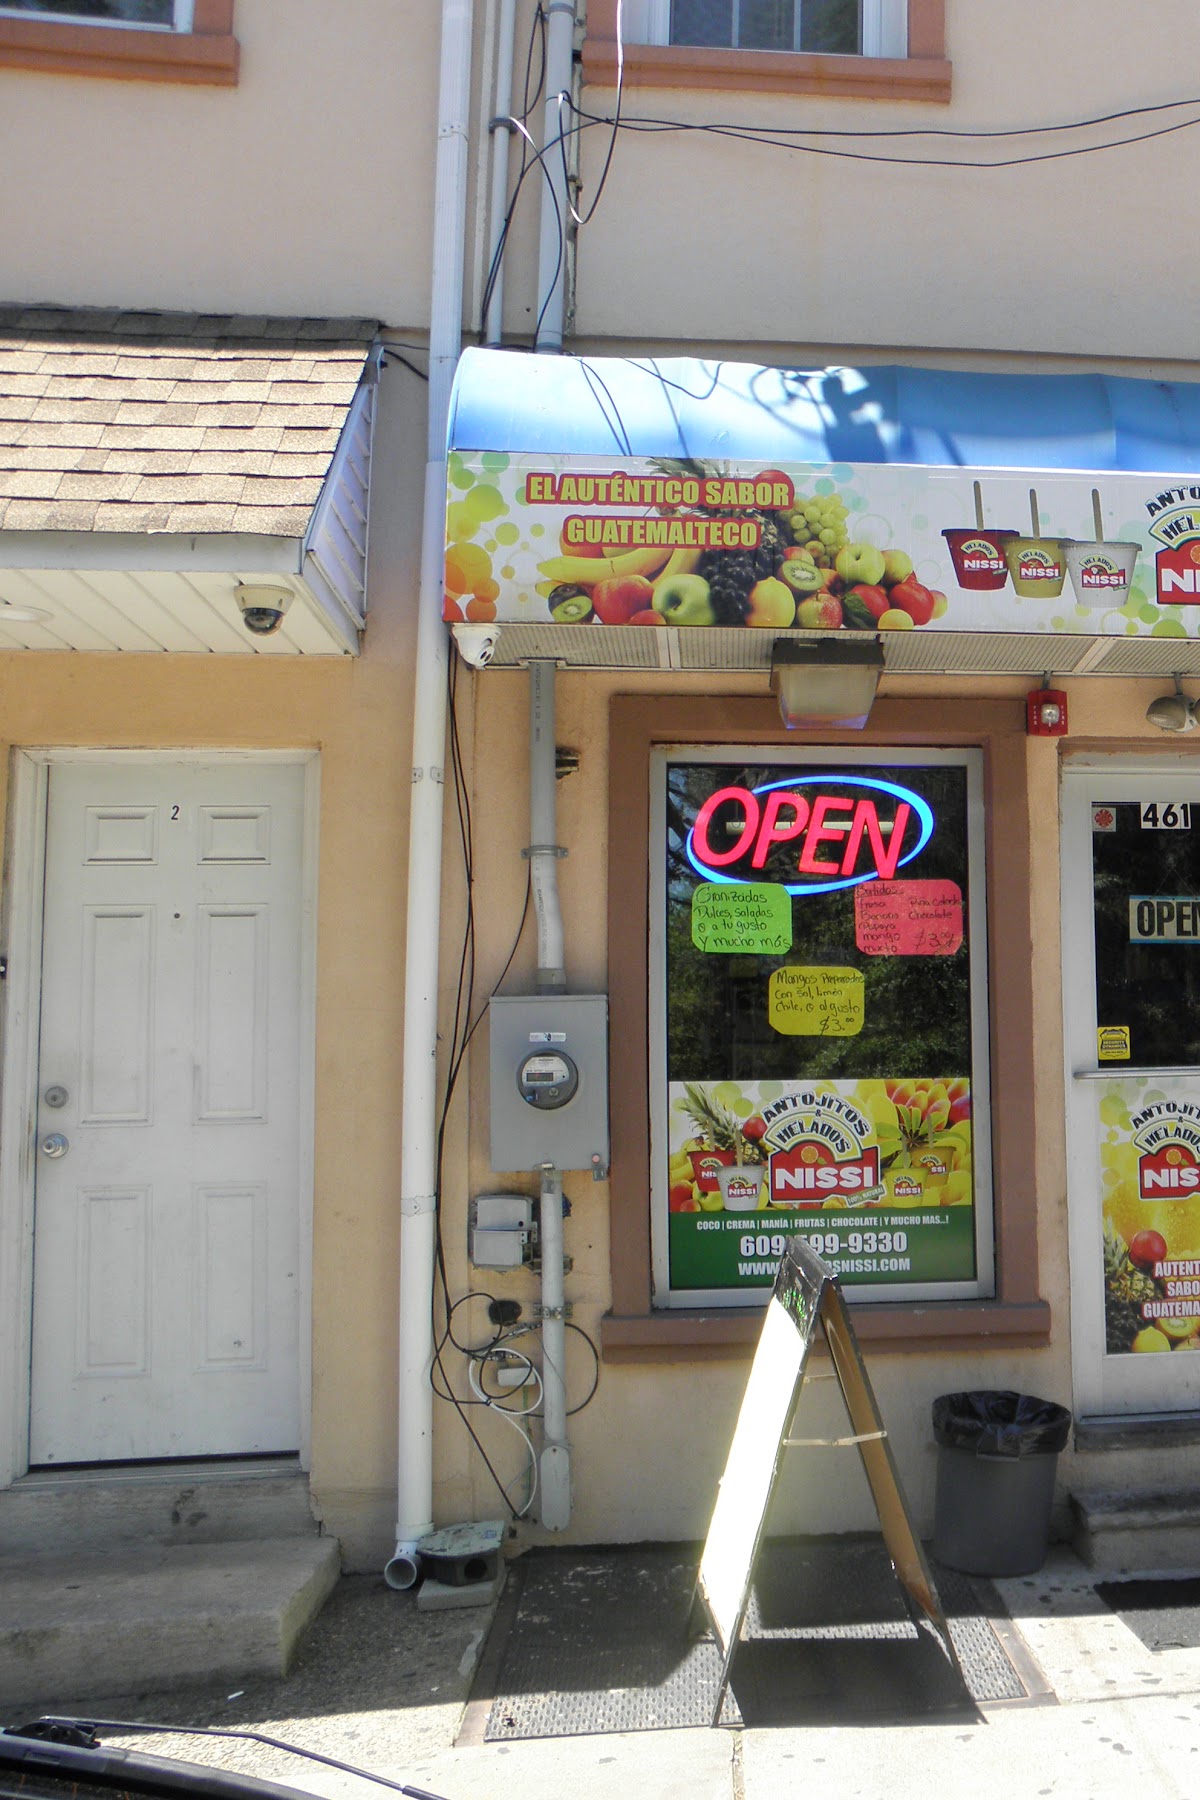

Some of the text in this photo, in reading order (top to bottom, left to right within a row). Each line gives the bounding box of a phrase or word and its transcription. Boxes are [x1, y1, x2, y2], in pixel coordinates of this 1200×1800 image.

[530, 473, 790, 507] EL AUTÉNTICO SABOR
[567, 518, 759, 548] GUATEMALTECO
[963, 559, 1004, 569] NISSI
[1021, 567, 1059, 577] NISSI
[1083, 574, 1123, 585] NISSI
[171, 805, 180, 821] 2
[1142, 803, 1190, 828] 461
[693, 786, 910, 880] OPEN
[696, 886, 767, 904] Granizadas
[736, 918, 767, 934] gusto
[713, 936, 755, 948] mucho
[776, 970, 818, 989] Mangos
[830, 999, 860, 1017] gusto
[762, 1091, 870, 1136] ANTOJITOS
[815, 1109, 822, 1117] &
[776, 1119, 851, 1153] HELADOS
[775, 1166, 873, 1190] NISSI
[697, 1220, 720, 1230] COCO
[726, 1220, 756, 1230] CREMA
[761, 1218, 788, 1229] MANÍA
[795, 1218, 826, 1228] FRUTAS
[831, 1217, 878, 1227] CHOCOLATE
[884, 1217, 891, 1226] Y
[891, 1216, 921, 1226] MUCHO
[740, 1231, 908, 1257] 60999-9330
